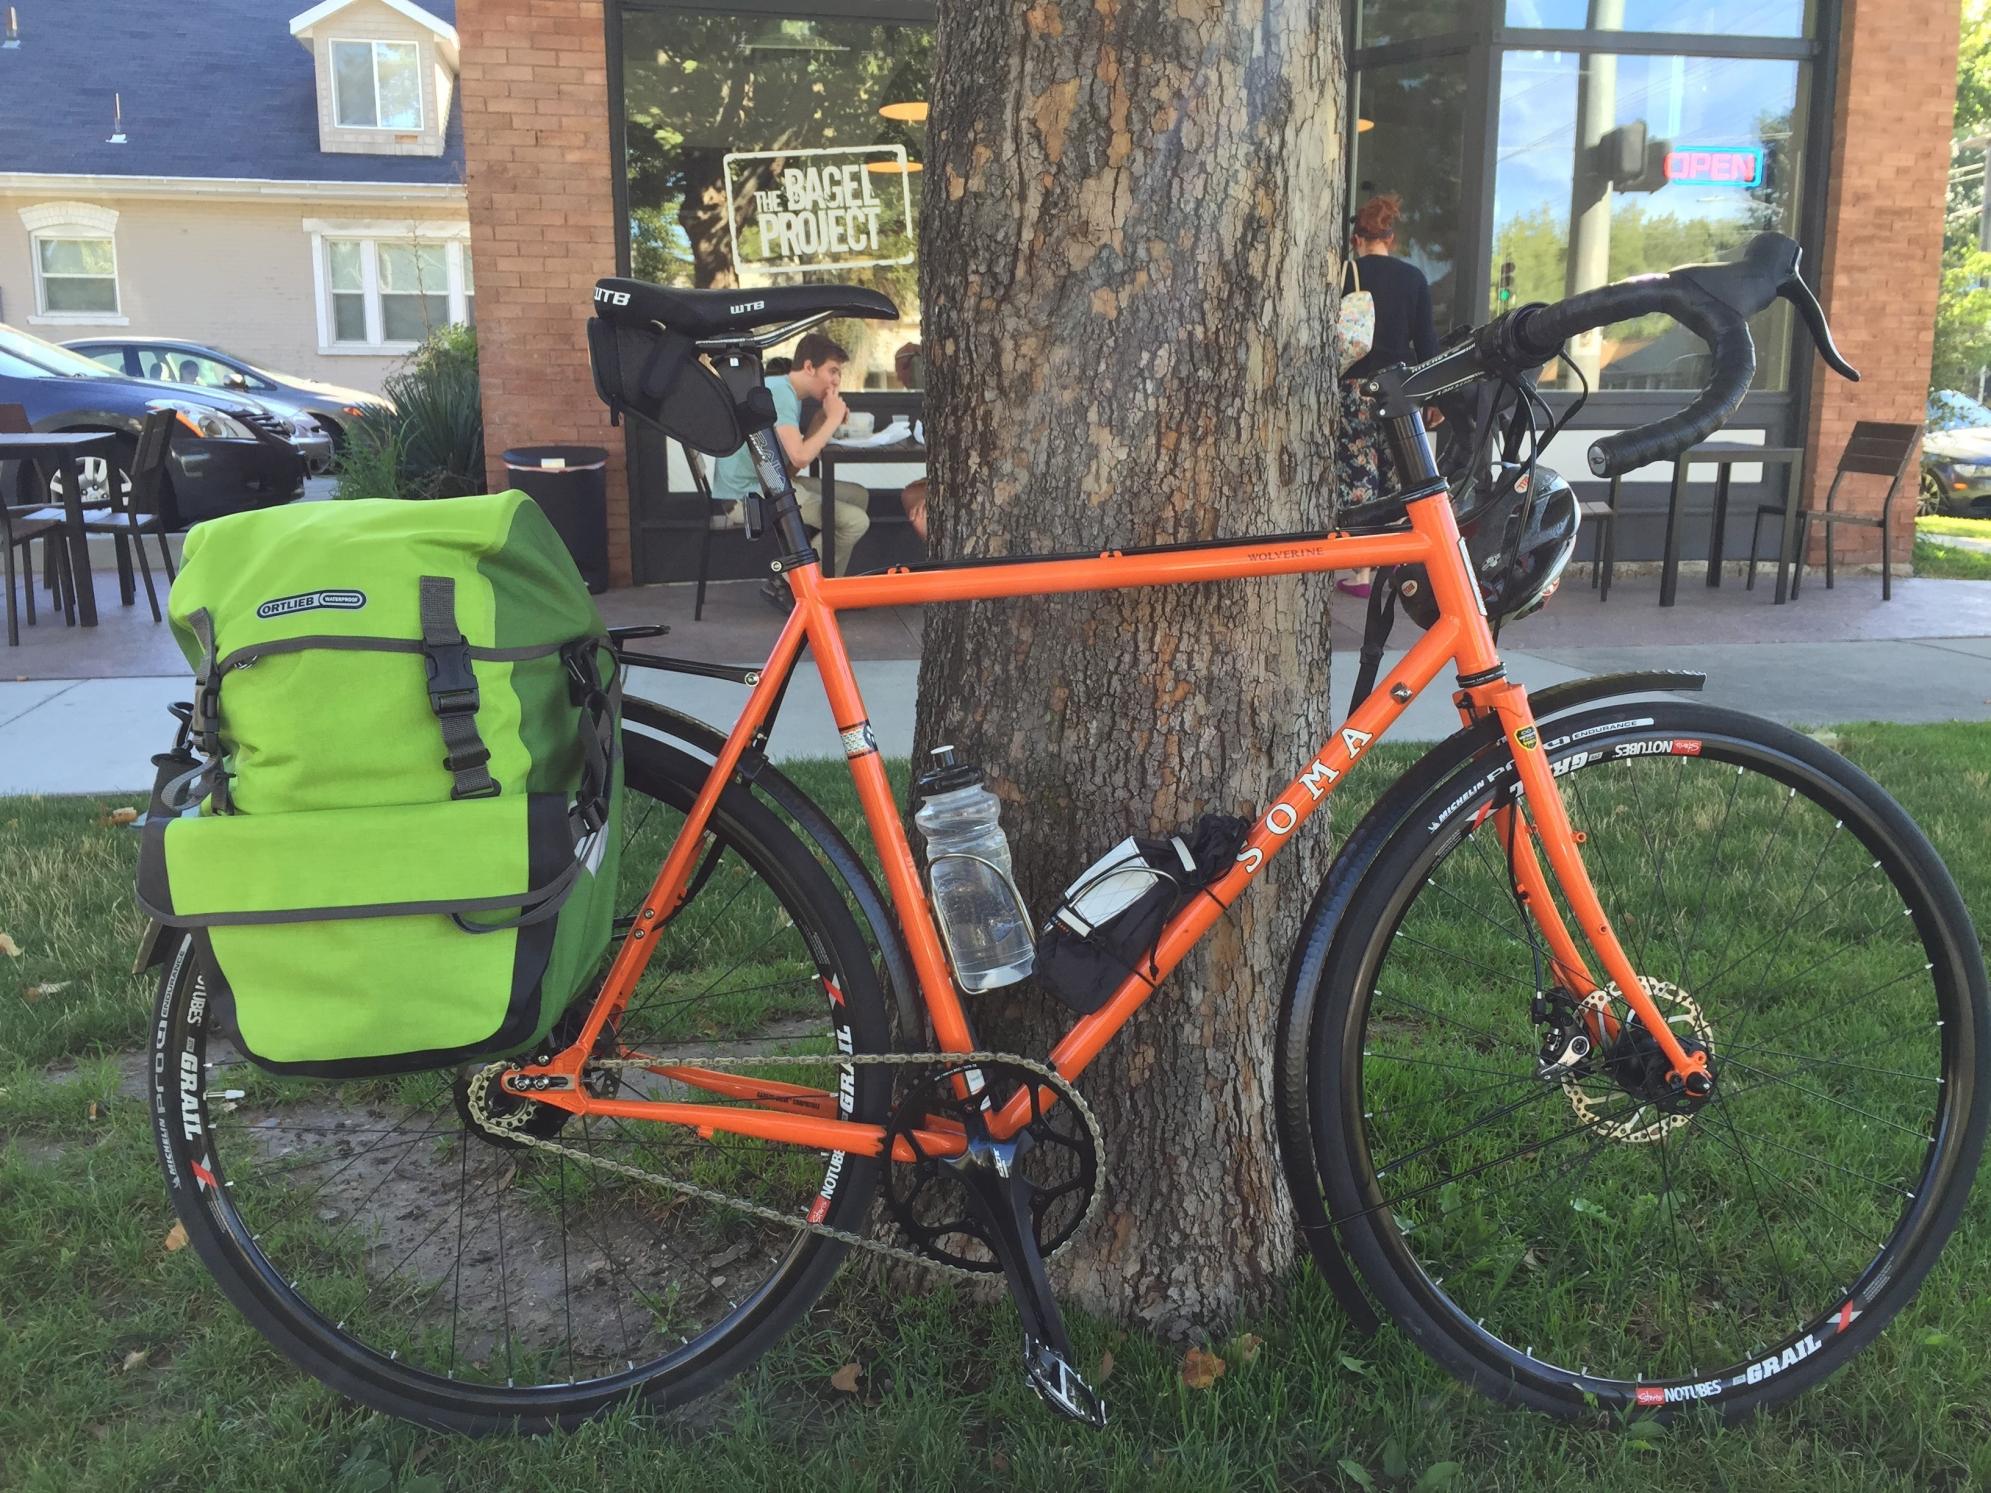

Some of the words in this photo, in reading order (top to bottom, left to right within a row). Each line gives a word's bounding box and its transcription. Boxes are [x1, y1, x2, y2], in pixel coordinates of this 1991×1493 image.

[754, 190, 783, 212] THE
[784, 164, 881, 211] BAGEL
[1664, 152, 1755, 182] OPEN
[758, 206, 881, 258] PROJECT
[730, 300, 765, 315] WTB
[1247, 547, 1325, 562] WOLVERINE
[262, 596, 314, 615] ORTLIEB
[324, 595, 359, 604] WATERPROOF
[1438, 779, 1485, 826] MICHELIN
[1574, 720, 1637, 740] ENDURANCE
[1614, 740, 1673, 758] NOTUBES
[1236, 728, 1373, 874] SOMA
[162, 950, 185, 1016] ENDURANCE
[180, 1051, 202, 1141] GRAIL
[157, 1118, 179, 1176] MICHELIN
[820, 1149, 846, 1200] NOTUBE
[1664, 1380, 1722, 1403] NOTUBES
[1746, 1333, 1823, 1385] GRAIL
